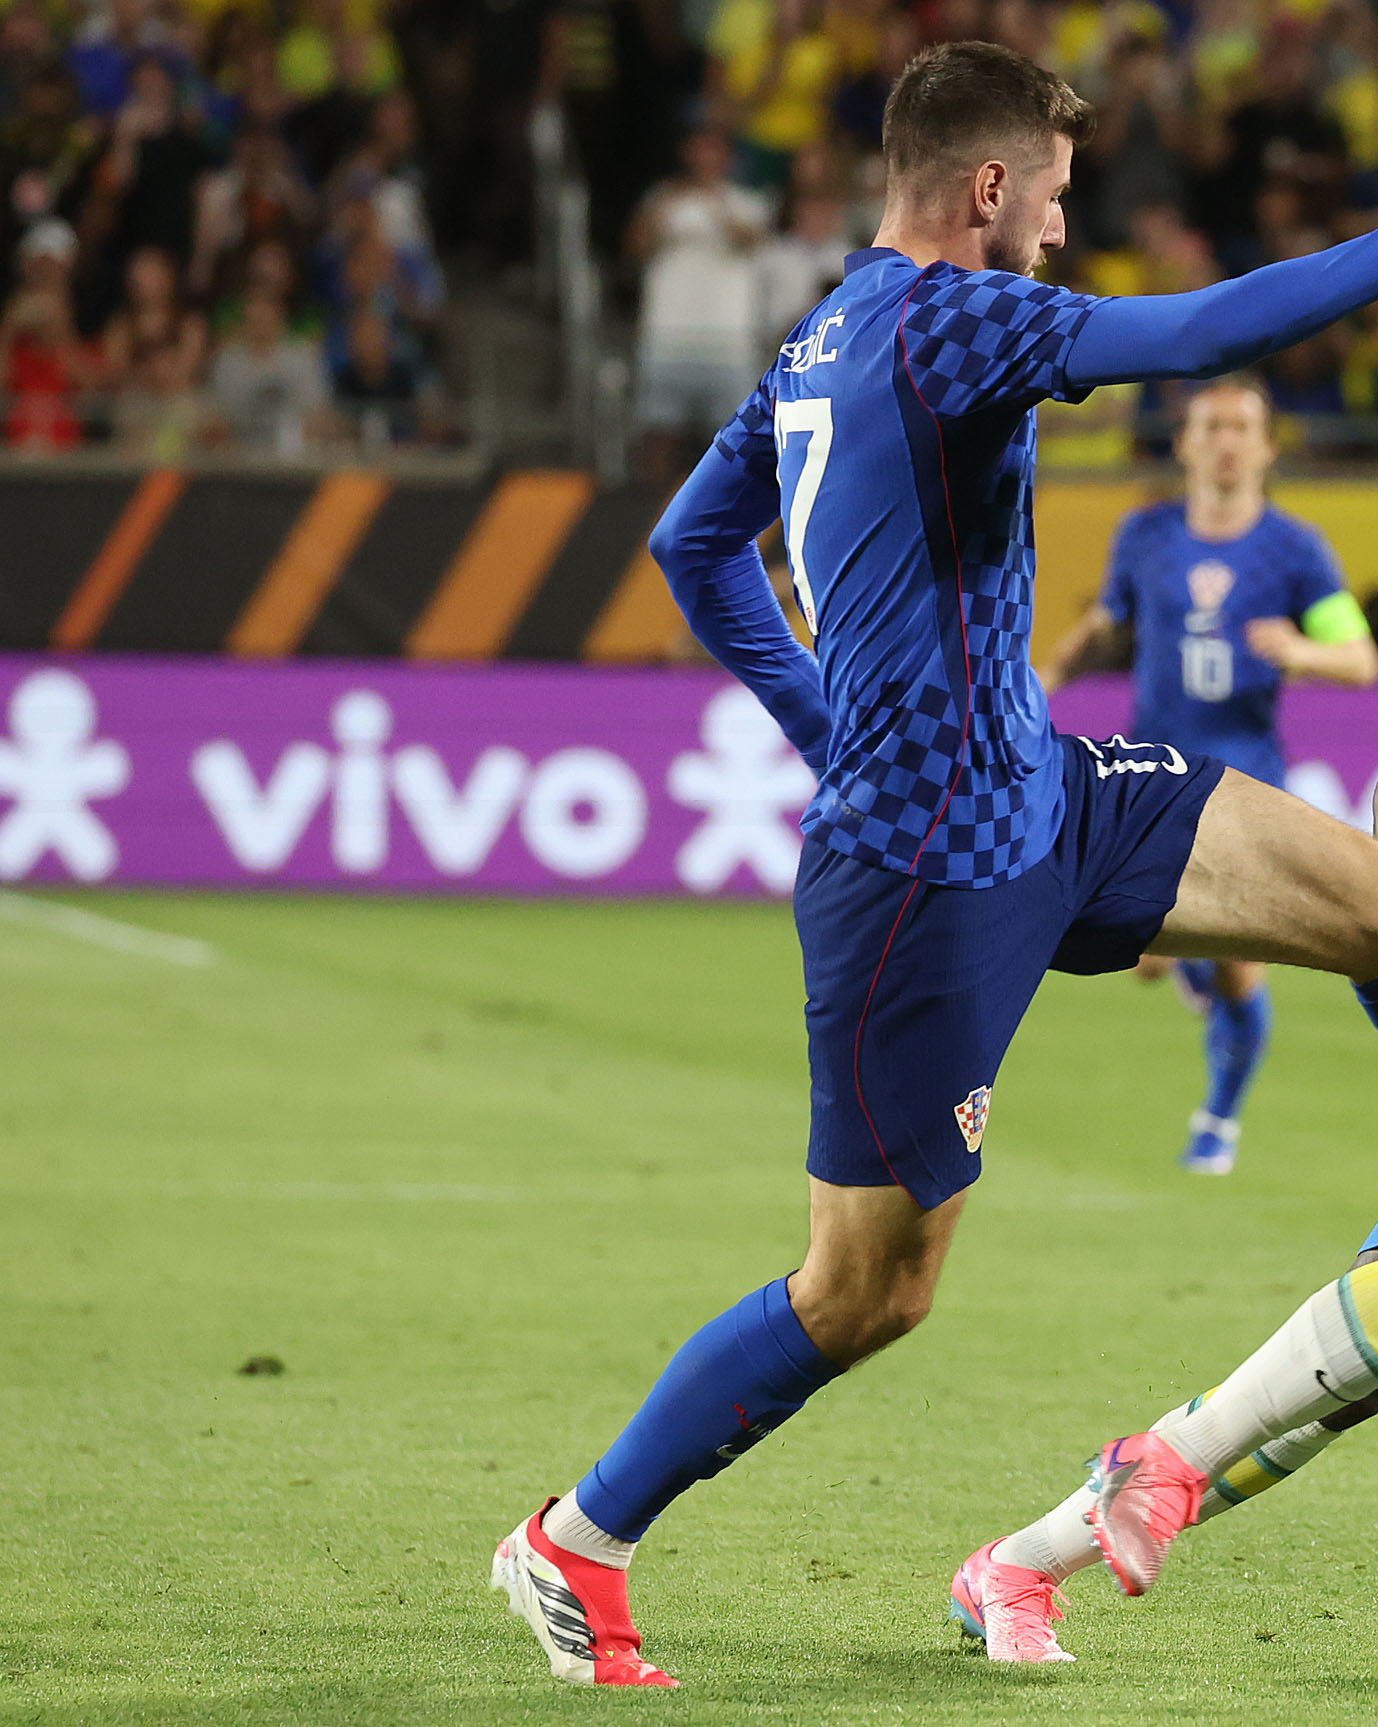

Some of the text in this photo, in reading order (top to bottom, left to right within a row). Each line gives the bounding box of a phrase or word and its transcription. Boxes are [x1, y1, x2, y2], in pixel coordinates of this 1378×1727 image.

[774, 398, 833, 636] 7
[1180, 634, 1234, 702] 10
[192, 689, 648, 879] vivo
